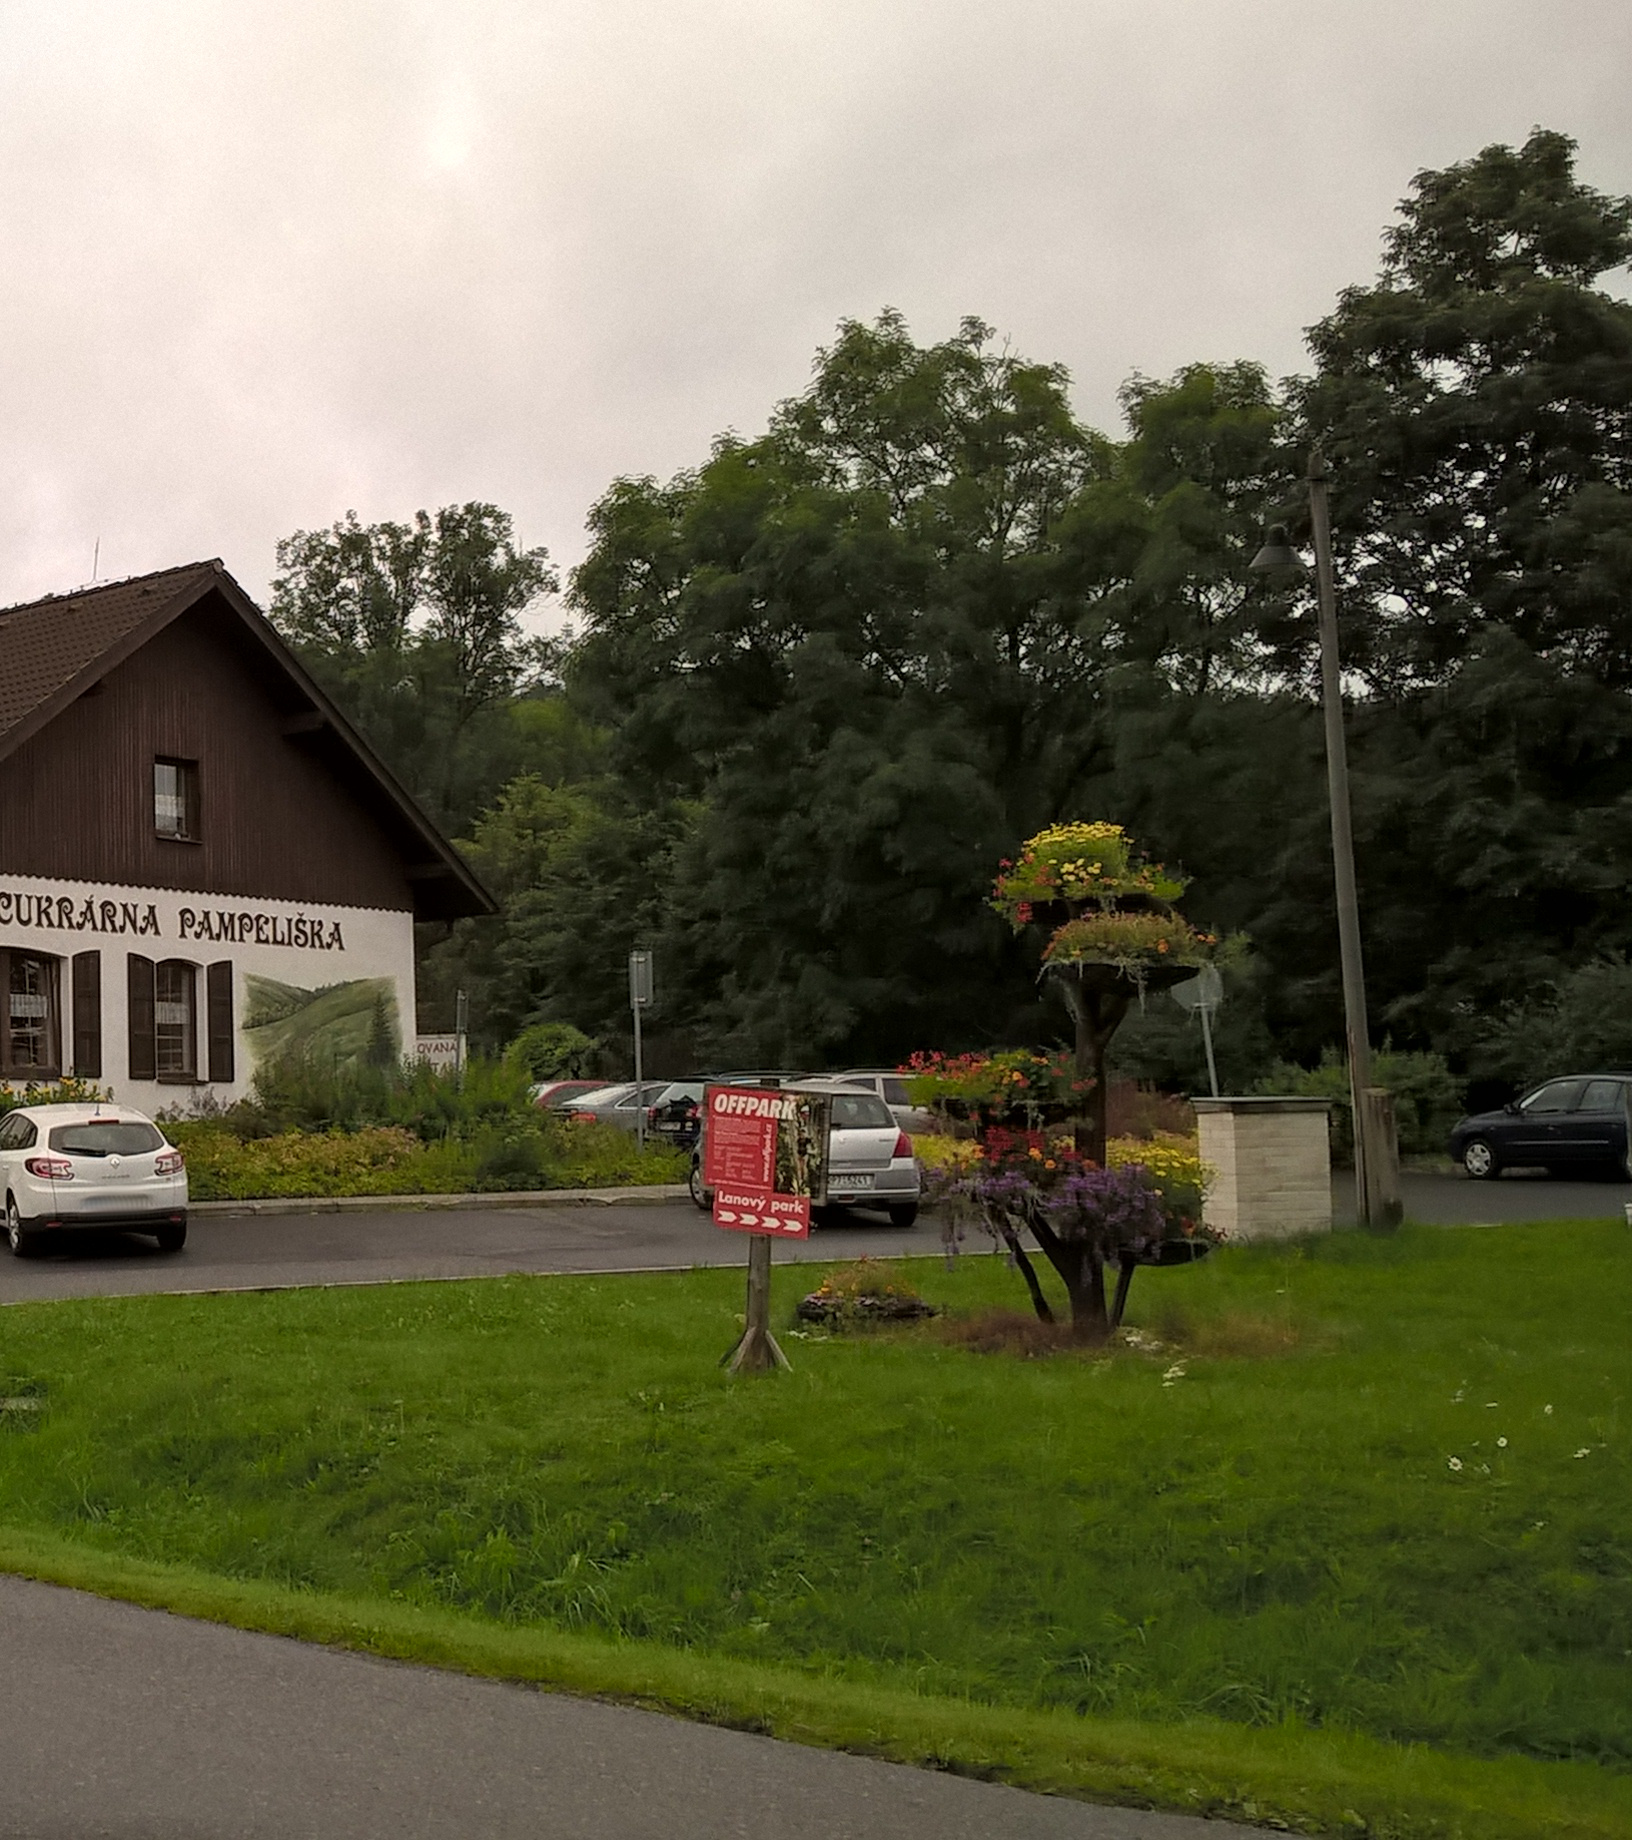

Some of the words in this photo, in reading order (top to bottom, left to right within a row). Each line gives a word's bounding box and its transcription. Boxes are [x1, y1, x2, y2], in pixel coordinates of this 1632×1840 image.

[179, 907, 346, 951] PAMPELIŠKA
[714, 1093, 797, 1120] OFFPARK
[718, 1190, 766, 1212] Lanový
[771, 1200, 804, 1214] park
